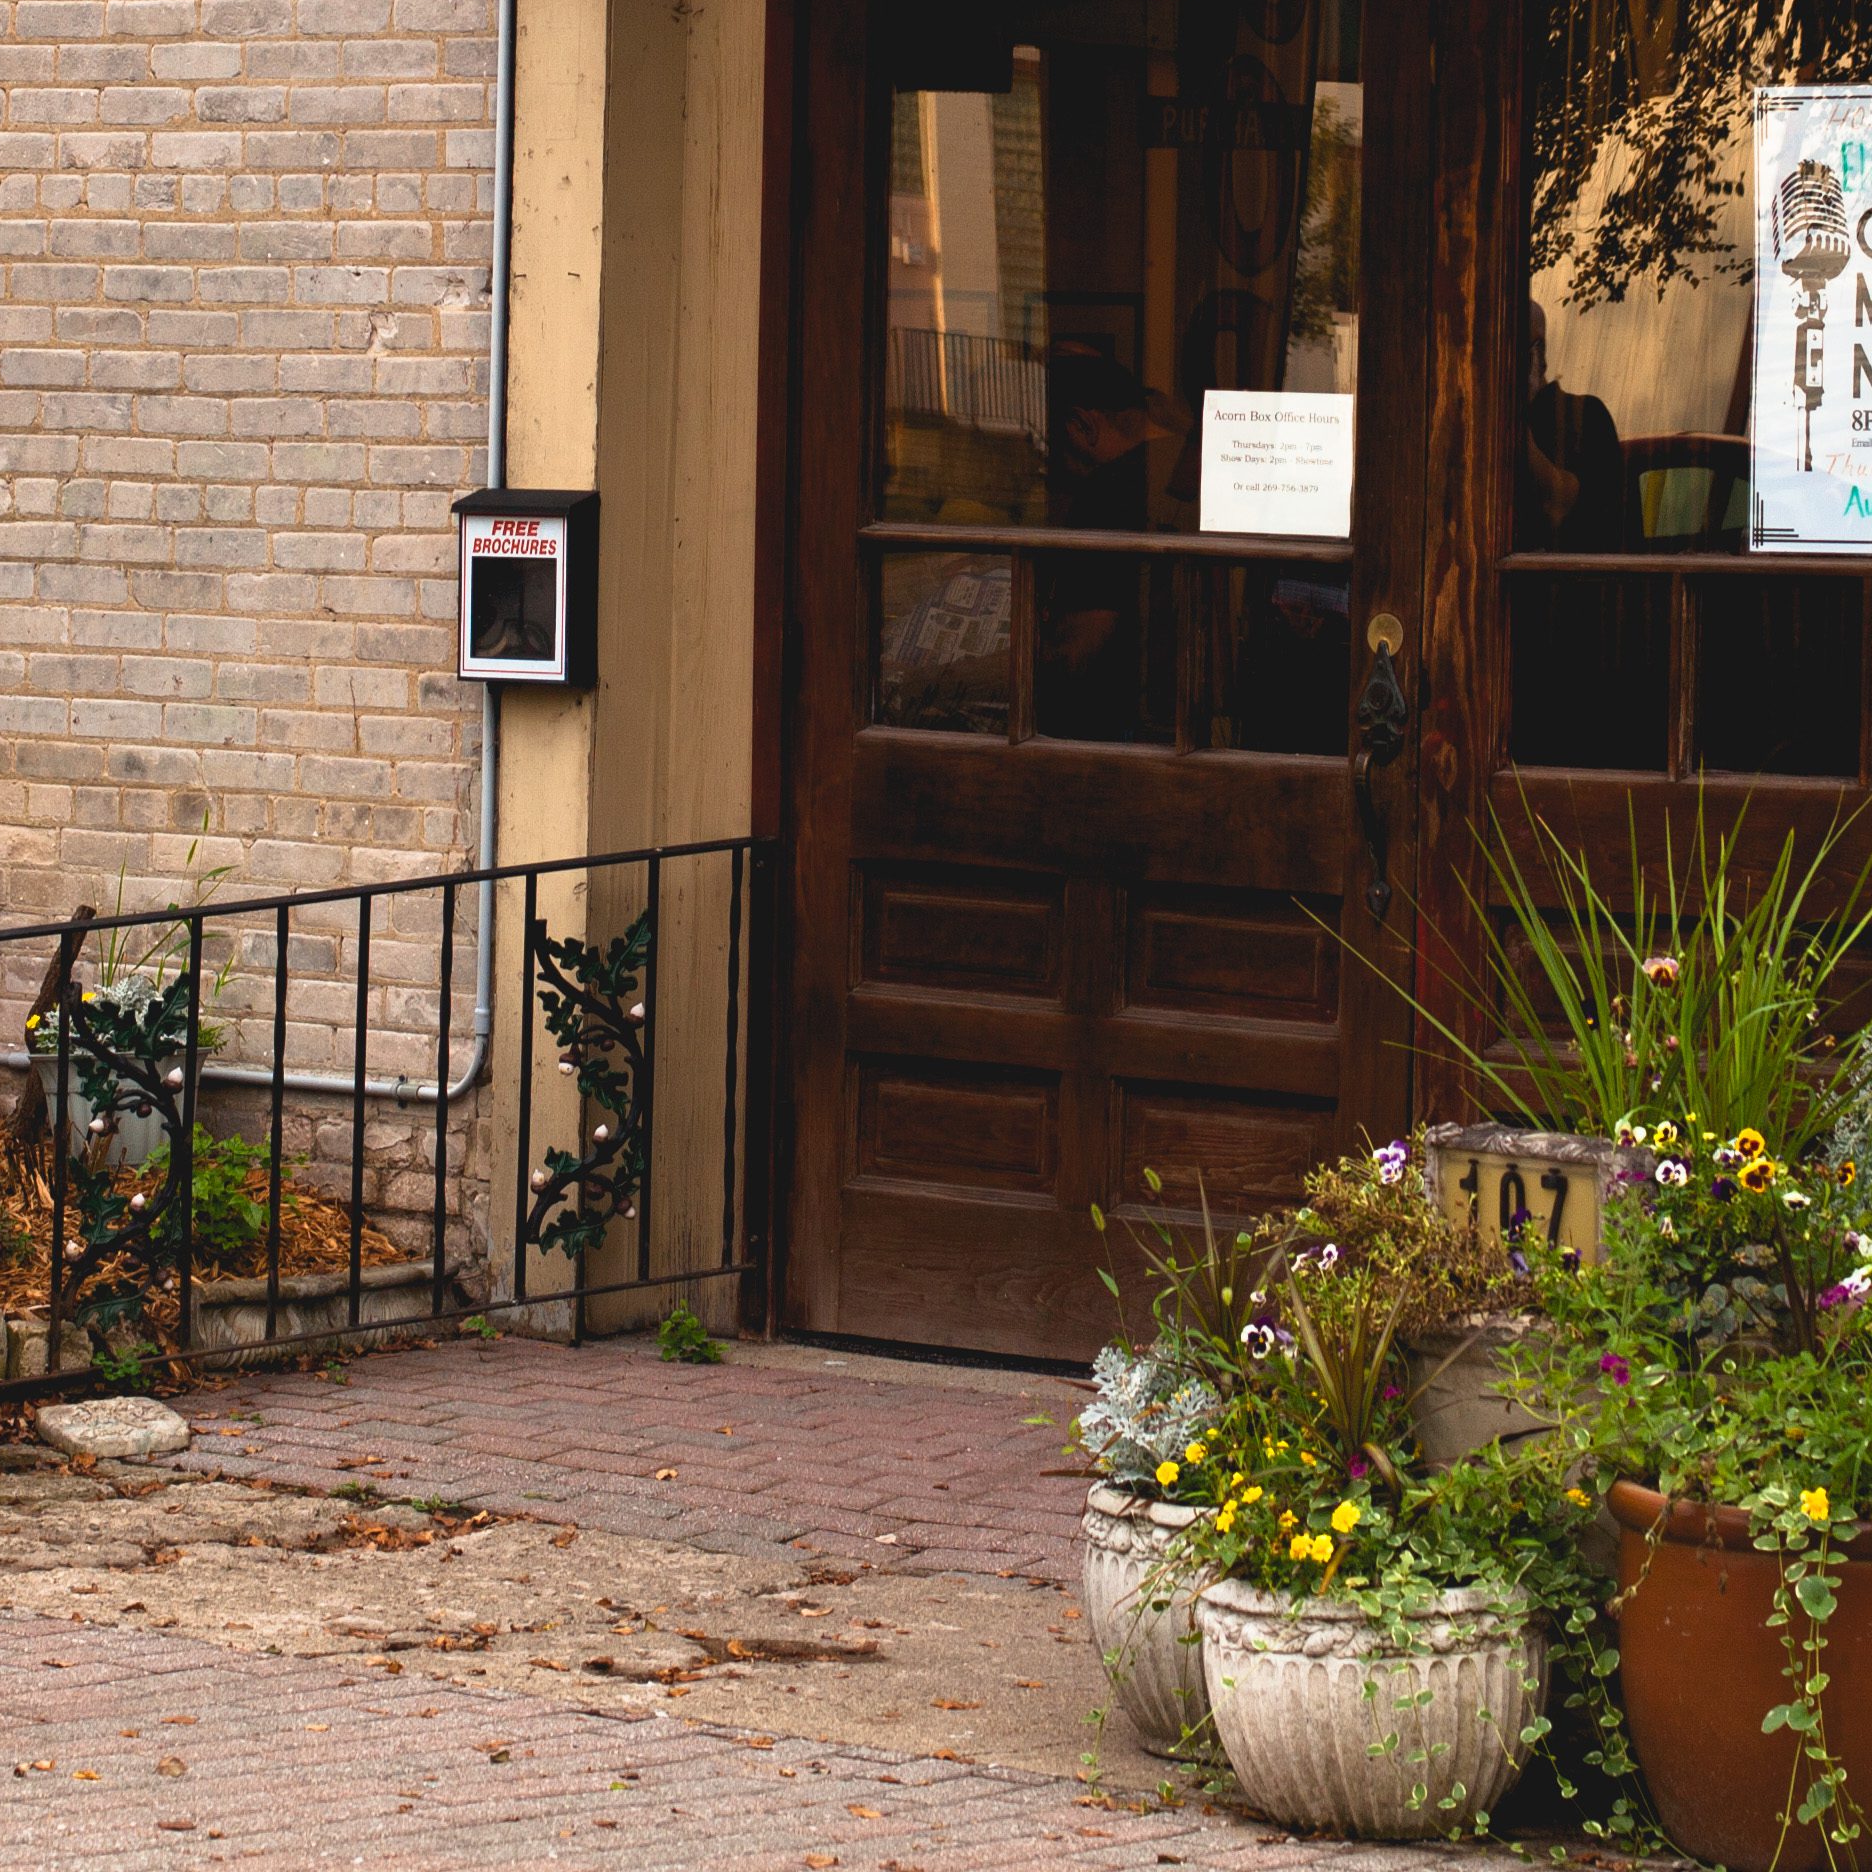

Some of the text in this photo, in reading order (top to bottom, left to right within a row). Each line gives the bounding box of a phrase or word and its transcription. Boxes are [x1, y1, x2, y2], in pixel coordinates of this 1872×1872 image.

[1214, 409, 1340, 425] Acorn Box Office Hours
[1851, 437, 1872, 449] Email
[1220, 453, 1243, 463] Show
[1233, 482, 1243, 492] Or
[1245, 483, 1260, 492] call
[491, 520, 541, 537] FREE
[472, 537, 558, 556] BROCHURES
[1458, 1158, 1569, 1252] 107
